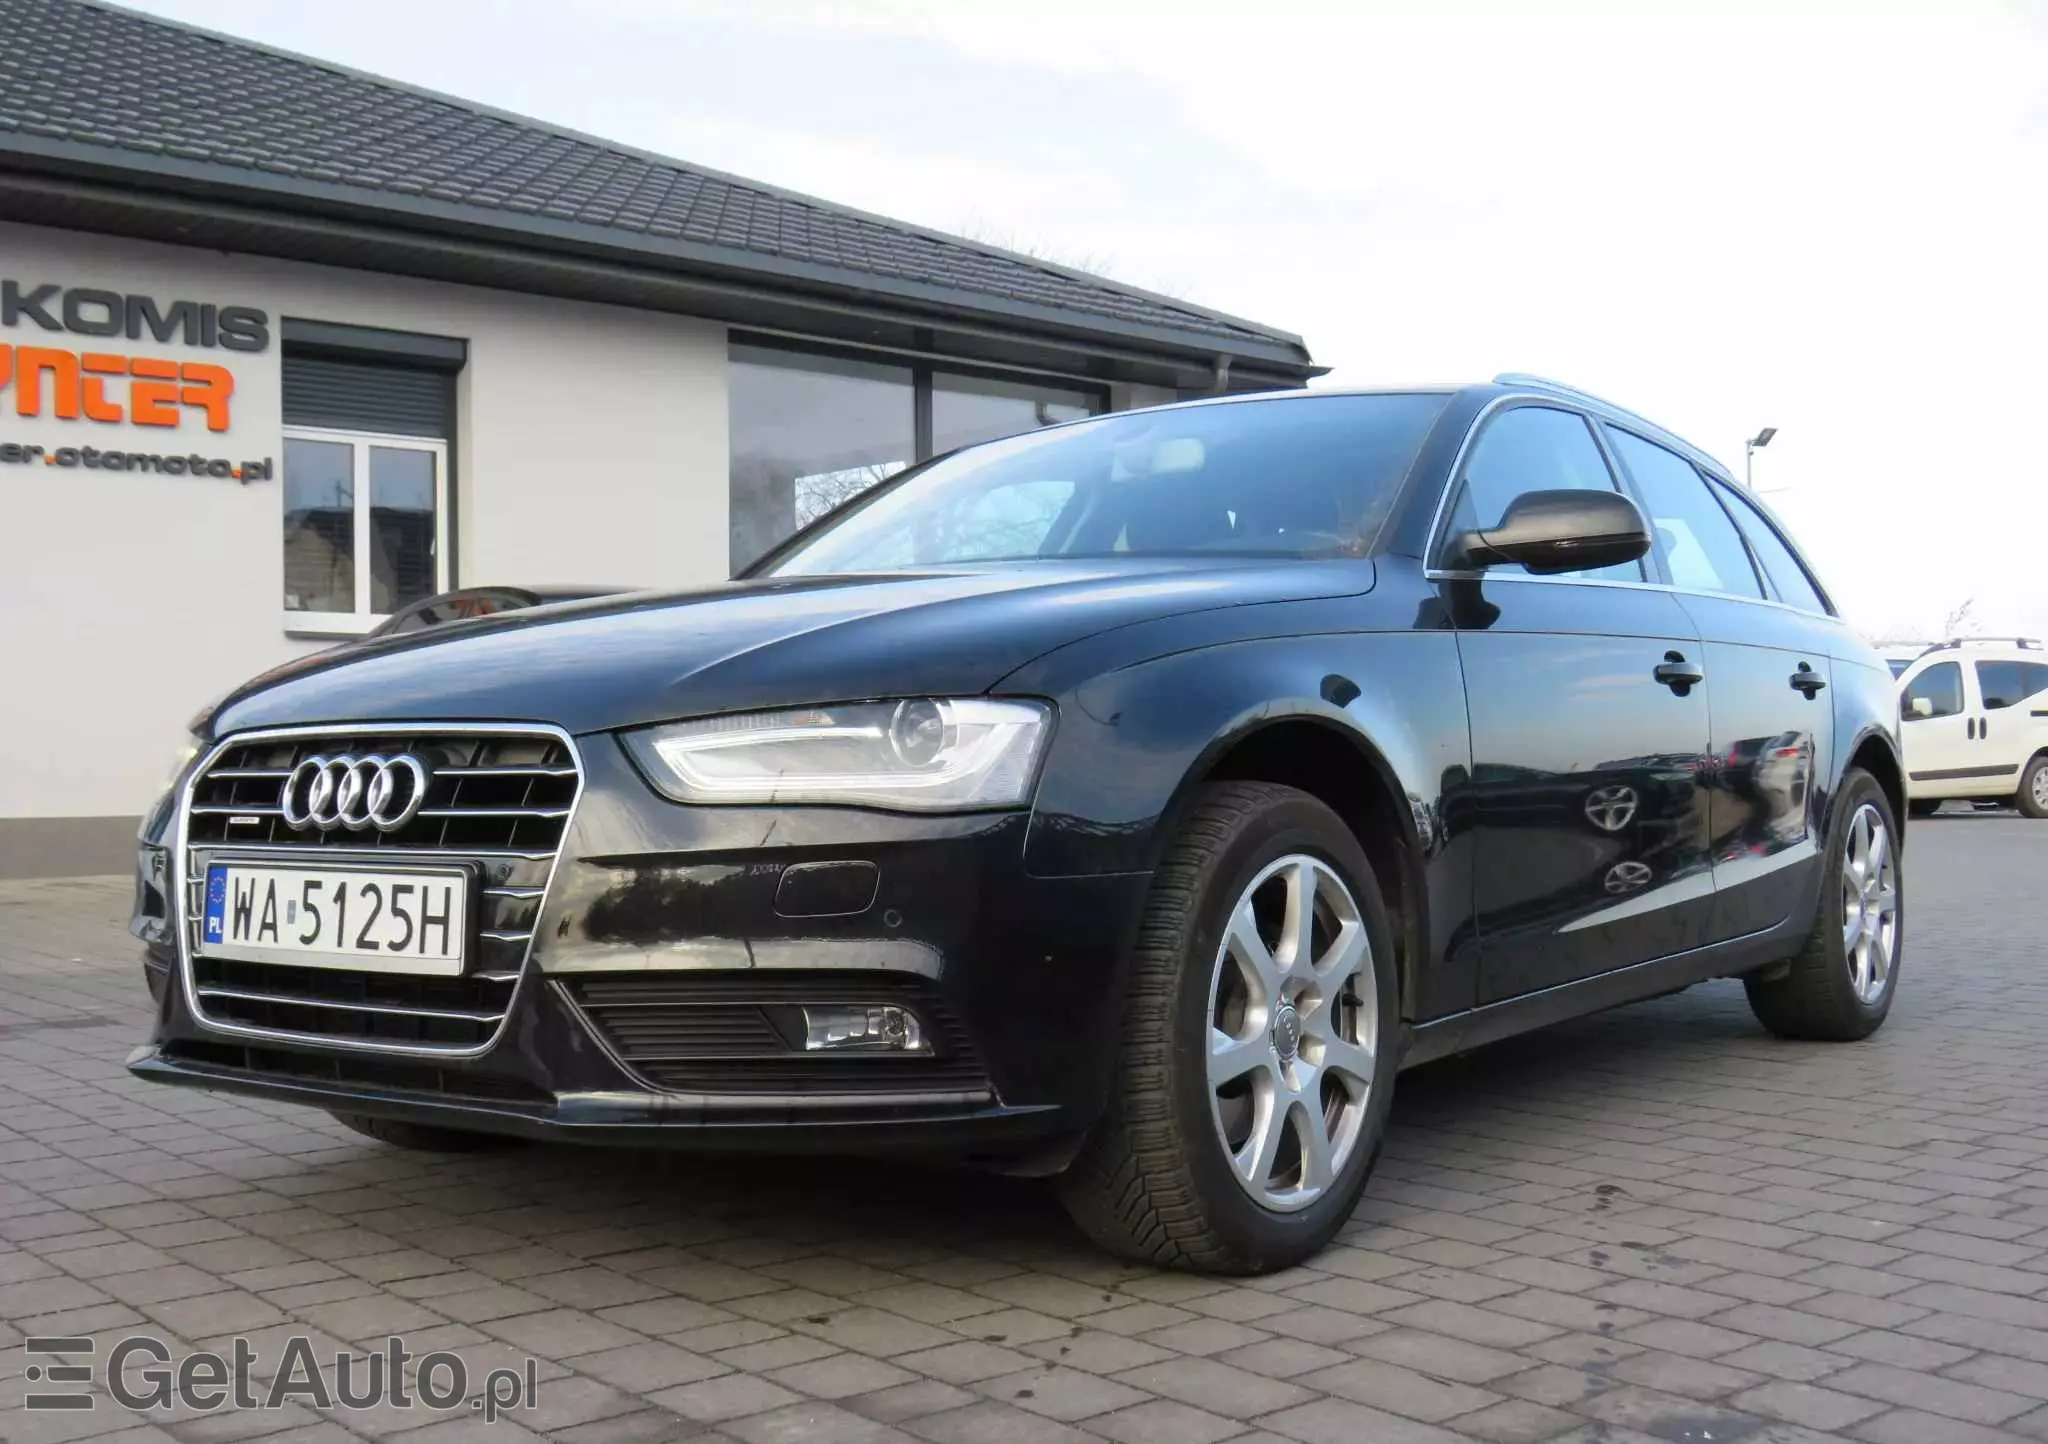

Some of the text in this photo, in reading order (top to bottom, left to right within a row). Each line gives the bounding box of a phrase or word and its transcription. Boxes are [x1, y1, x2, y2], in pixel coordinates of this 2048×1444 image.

[2, 280, 270, 352] KOMIS
[209, 916, 222, 934] PL
[233, 877, 452, 955] WA 5125H
